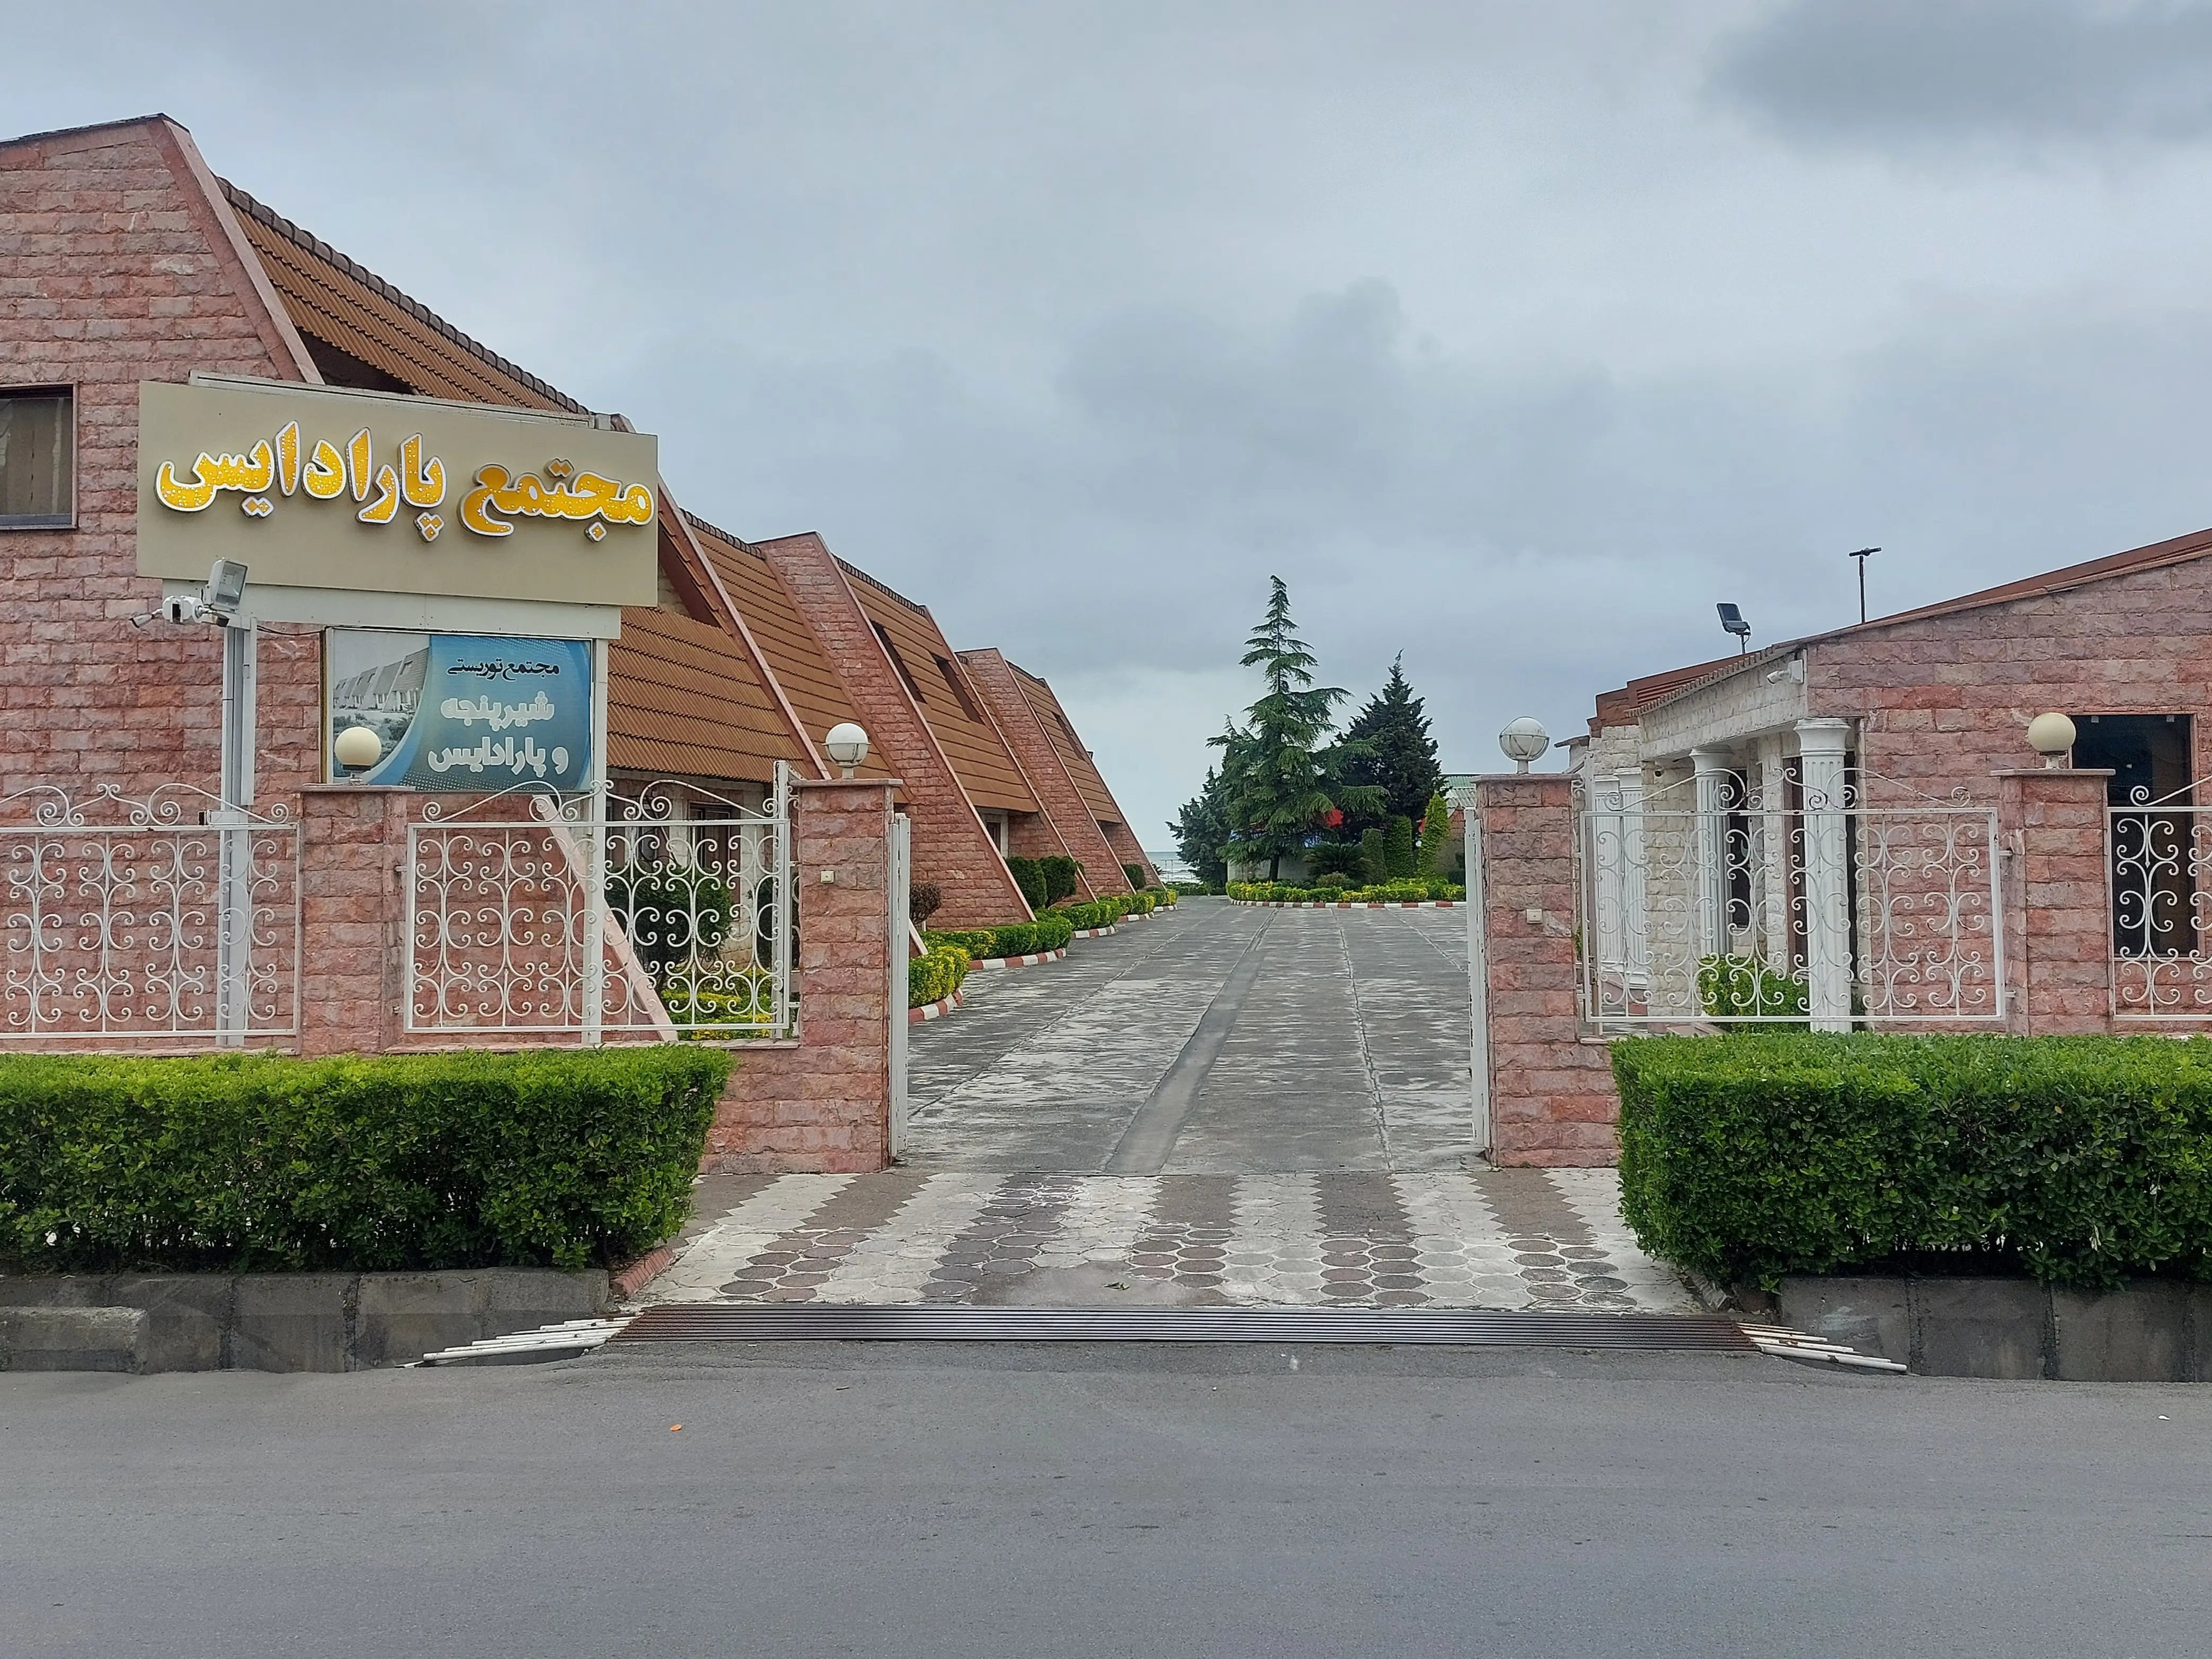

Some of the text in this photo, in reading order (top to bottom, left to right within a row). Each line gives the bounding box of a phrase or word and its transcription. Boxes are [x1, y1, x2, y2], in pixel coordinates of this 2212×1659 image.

[155, 420, 655, 543] مجتمع پارادایس
[447, 658, 559, 681] مجتمع توریستی
[428, 736, 568, 778] و پارادایس
